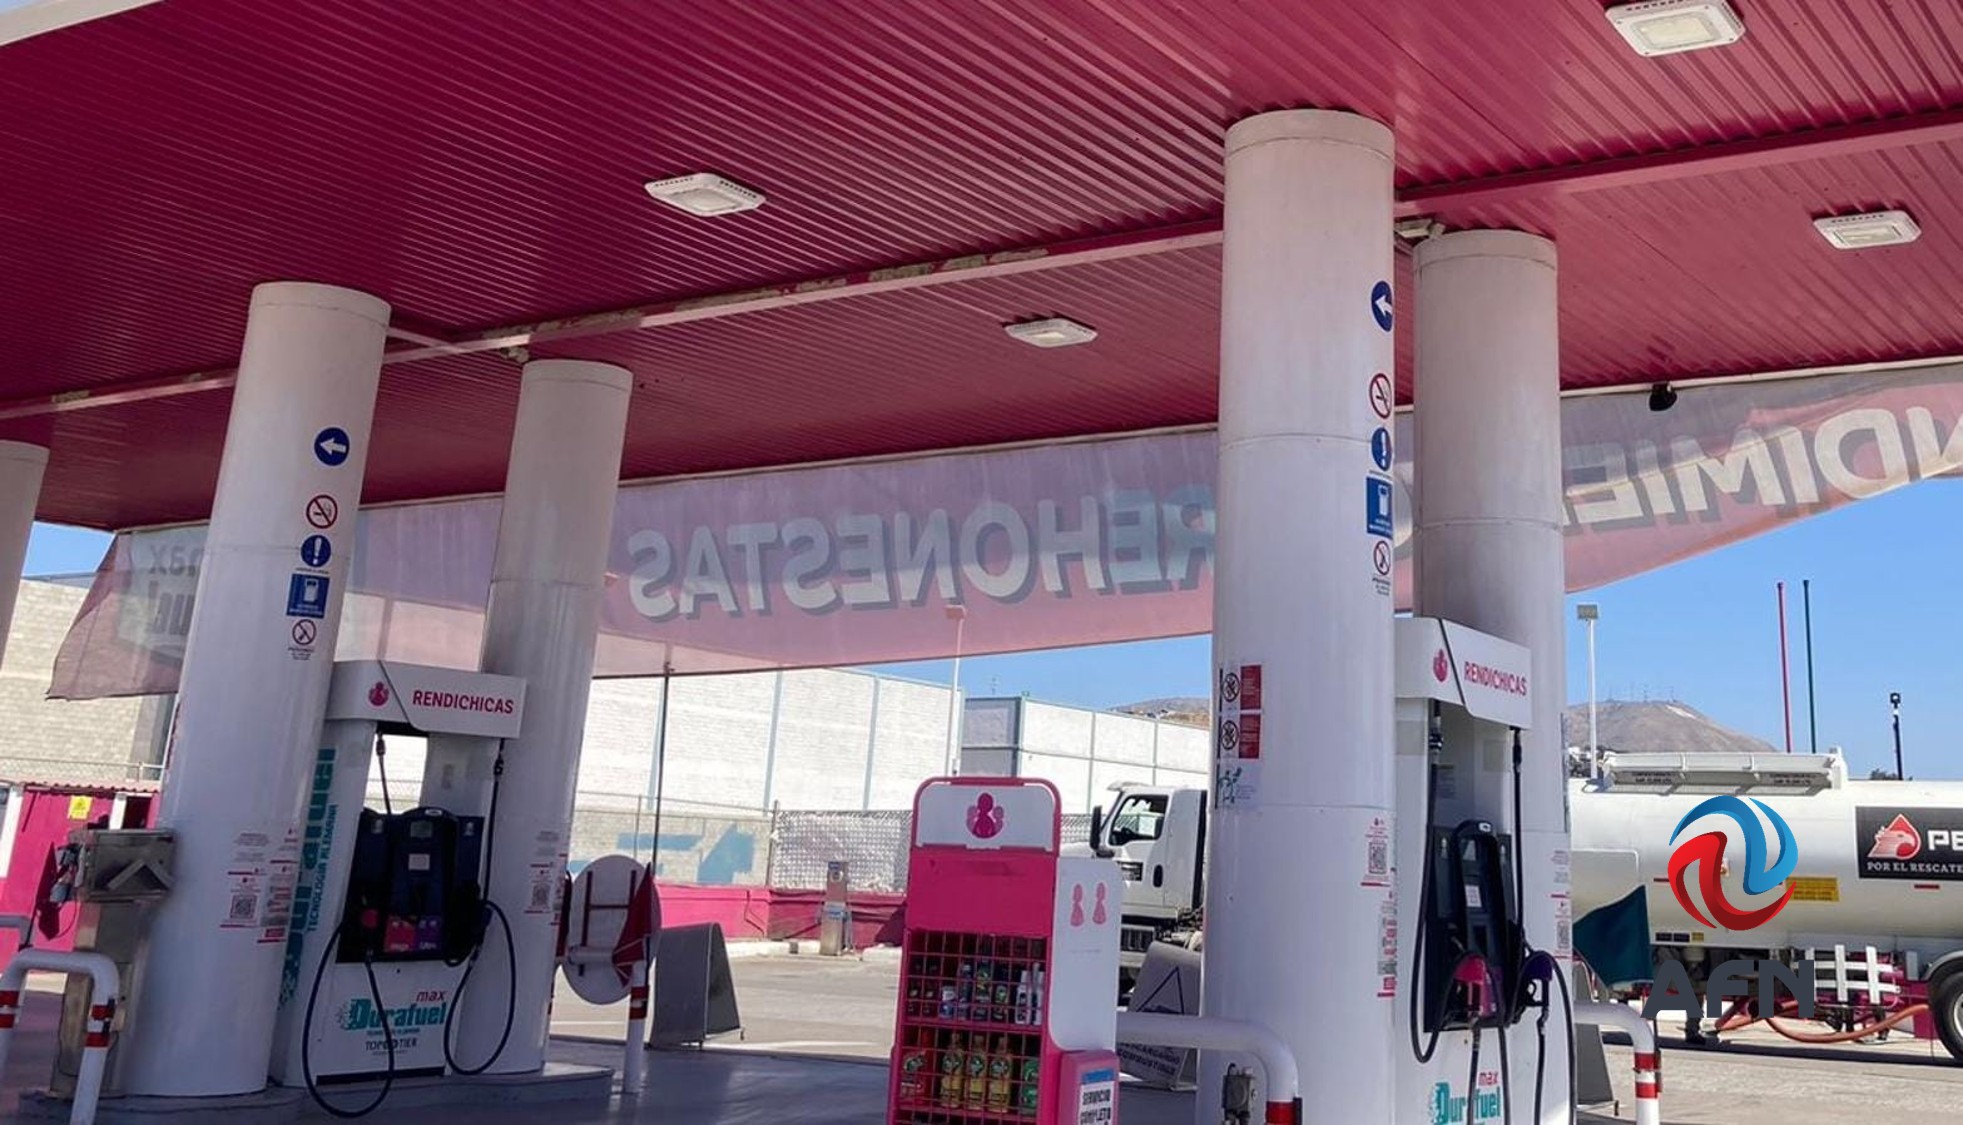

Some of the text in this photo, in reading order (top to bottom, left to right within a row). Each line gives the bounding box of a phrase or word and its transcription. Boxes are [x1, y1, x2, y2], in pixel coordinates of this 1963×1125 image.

[1464, 661, 1527, 696] RENDICHICAS
[412, 690, 514, 714] RENDICHICAS
[1867, 862, 1963, 873] POR EL RESCATE
[416, 991, 446, 1002] max
[1479, 1071, 1499, 1085] max
